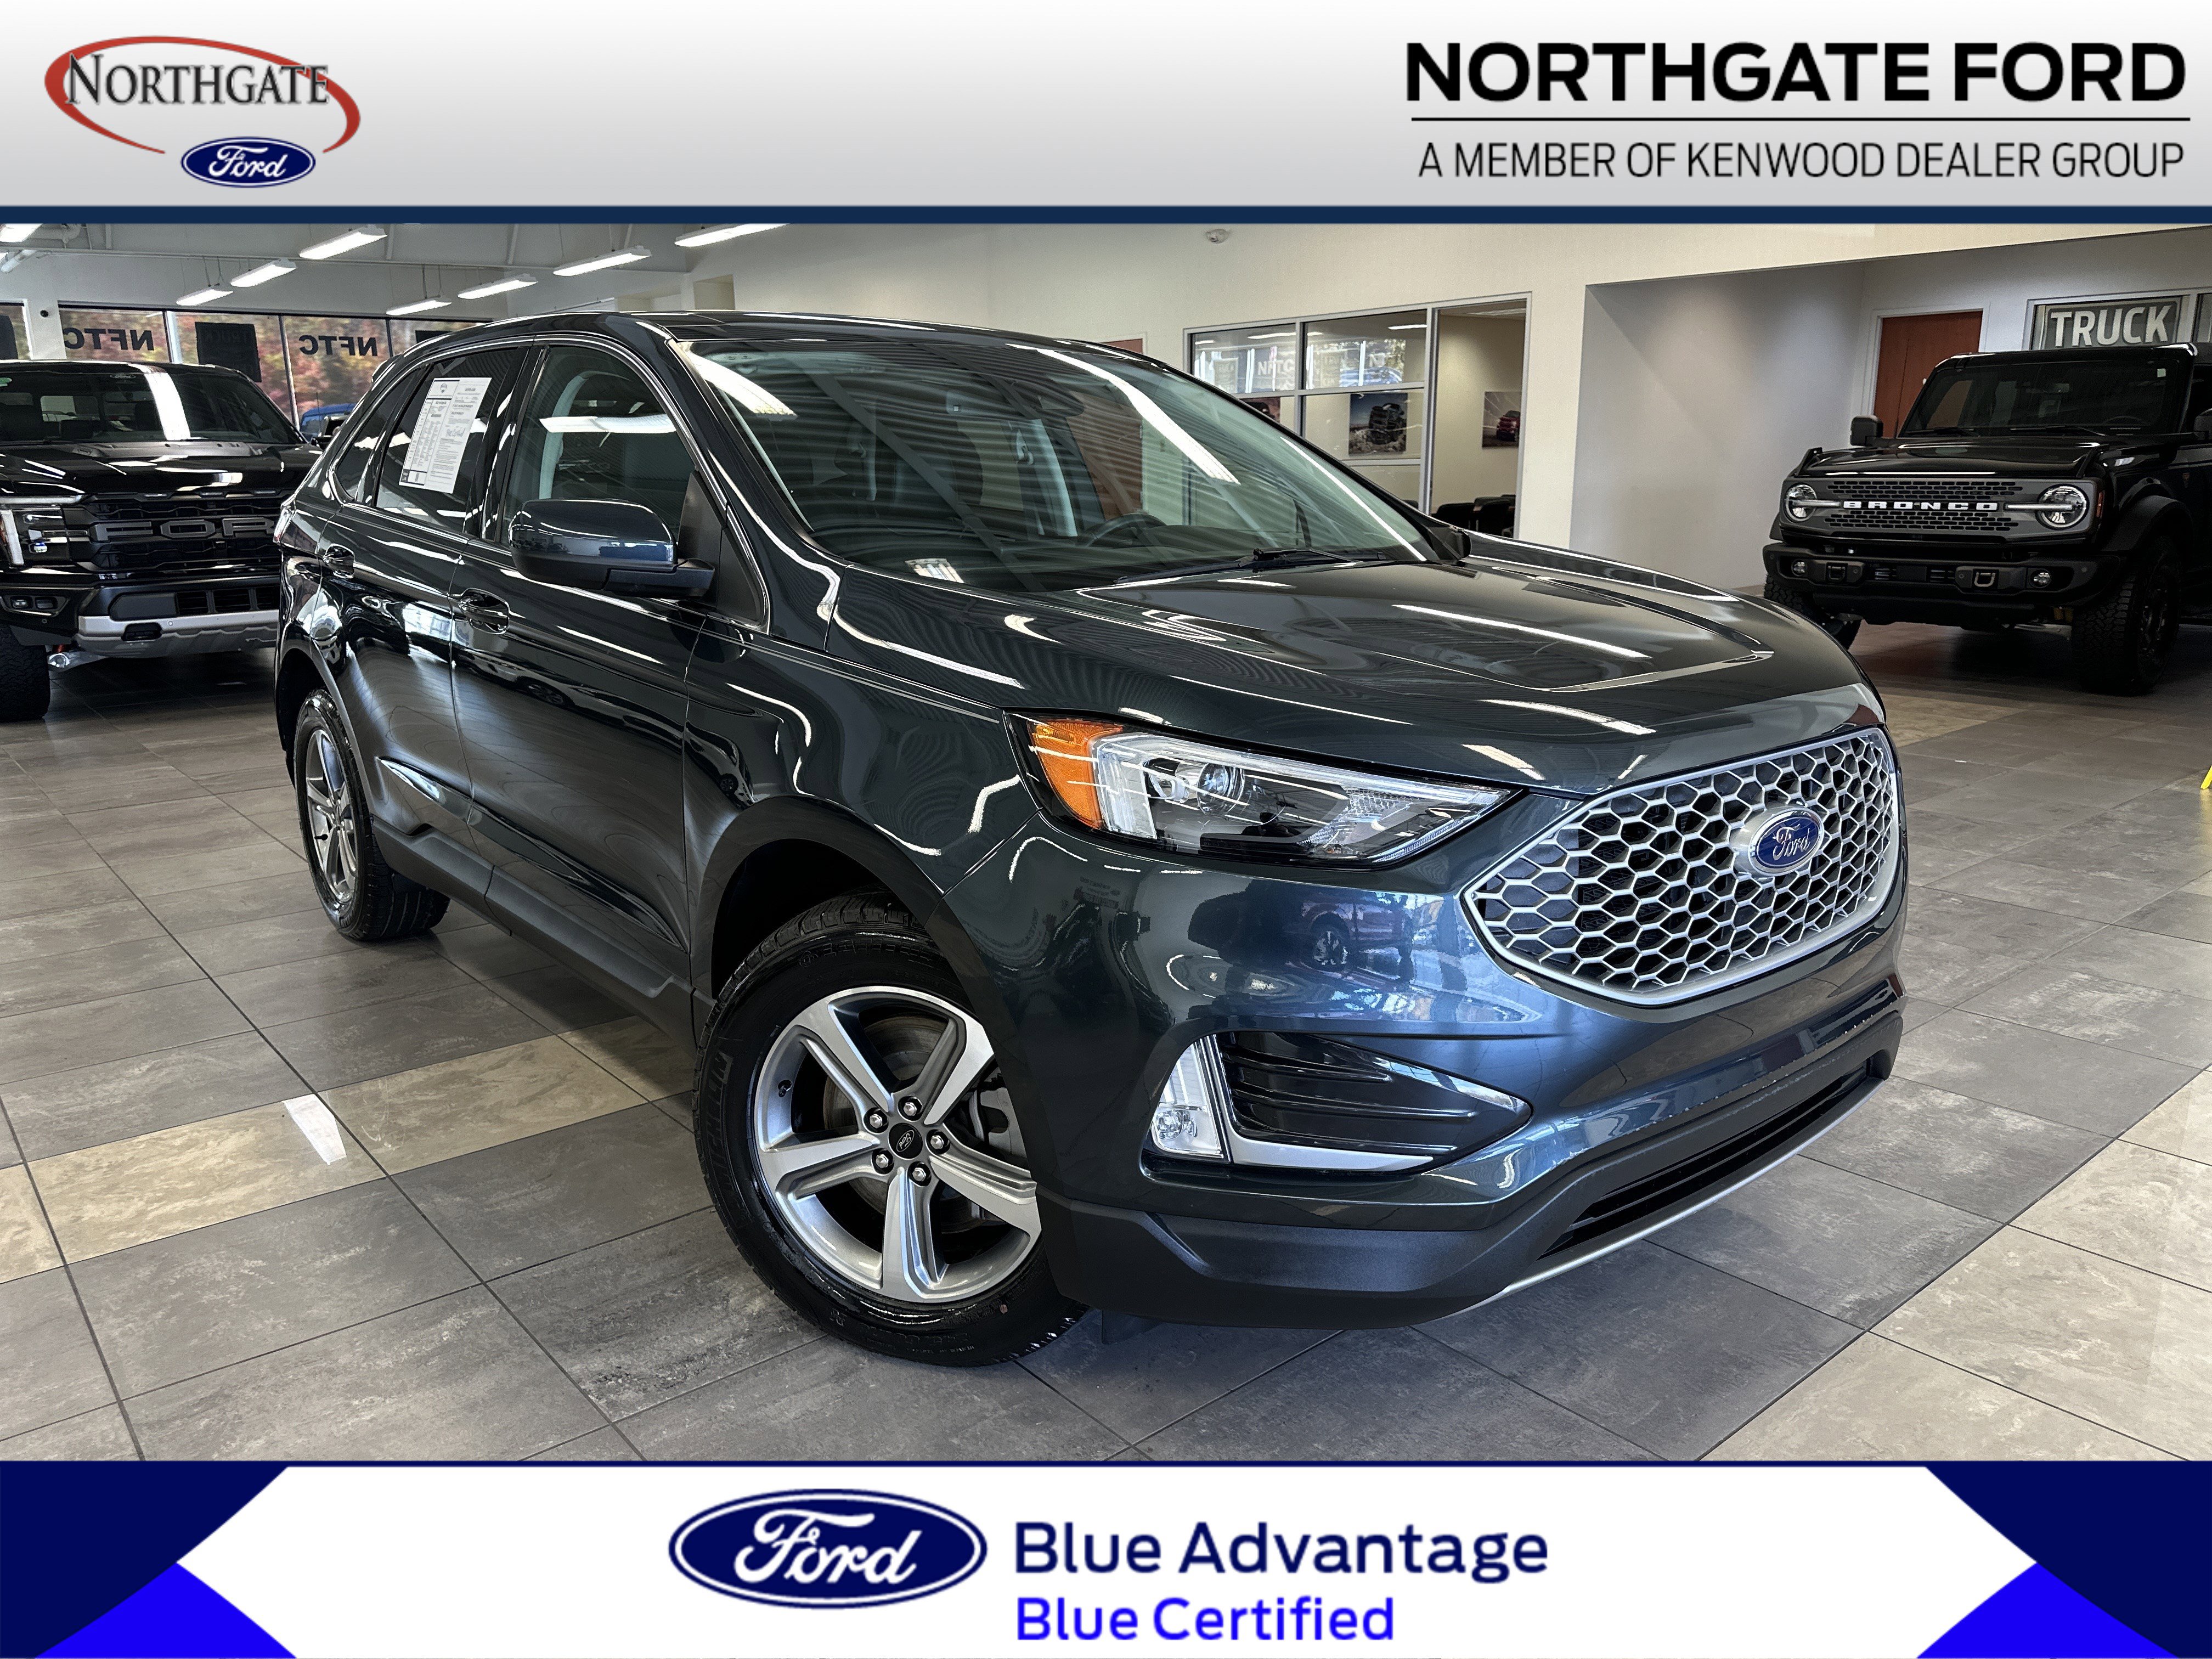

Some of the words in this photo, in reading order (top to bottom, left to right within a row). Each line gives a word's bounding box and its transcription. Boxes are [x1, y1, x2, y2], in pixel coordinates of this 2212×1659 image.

[2050, 305, 2172, 347] TRUCK
[1842, 500, 1998, 511] BRONCO
[1771, 822, 1811, 861] Ford
[898, 1132, 911, 1149] Ford
